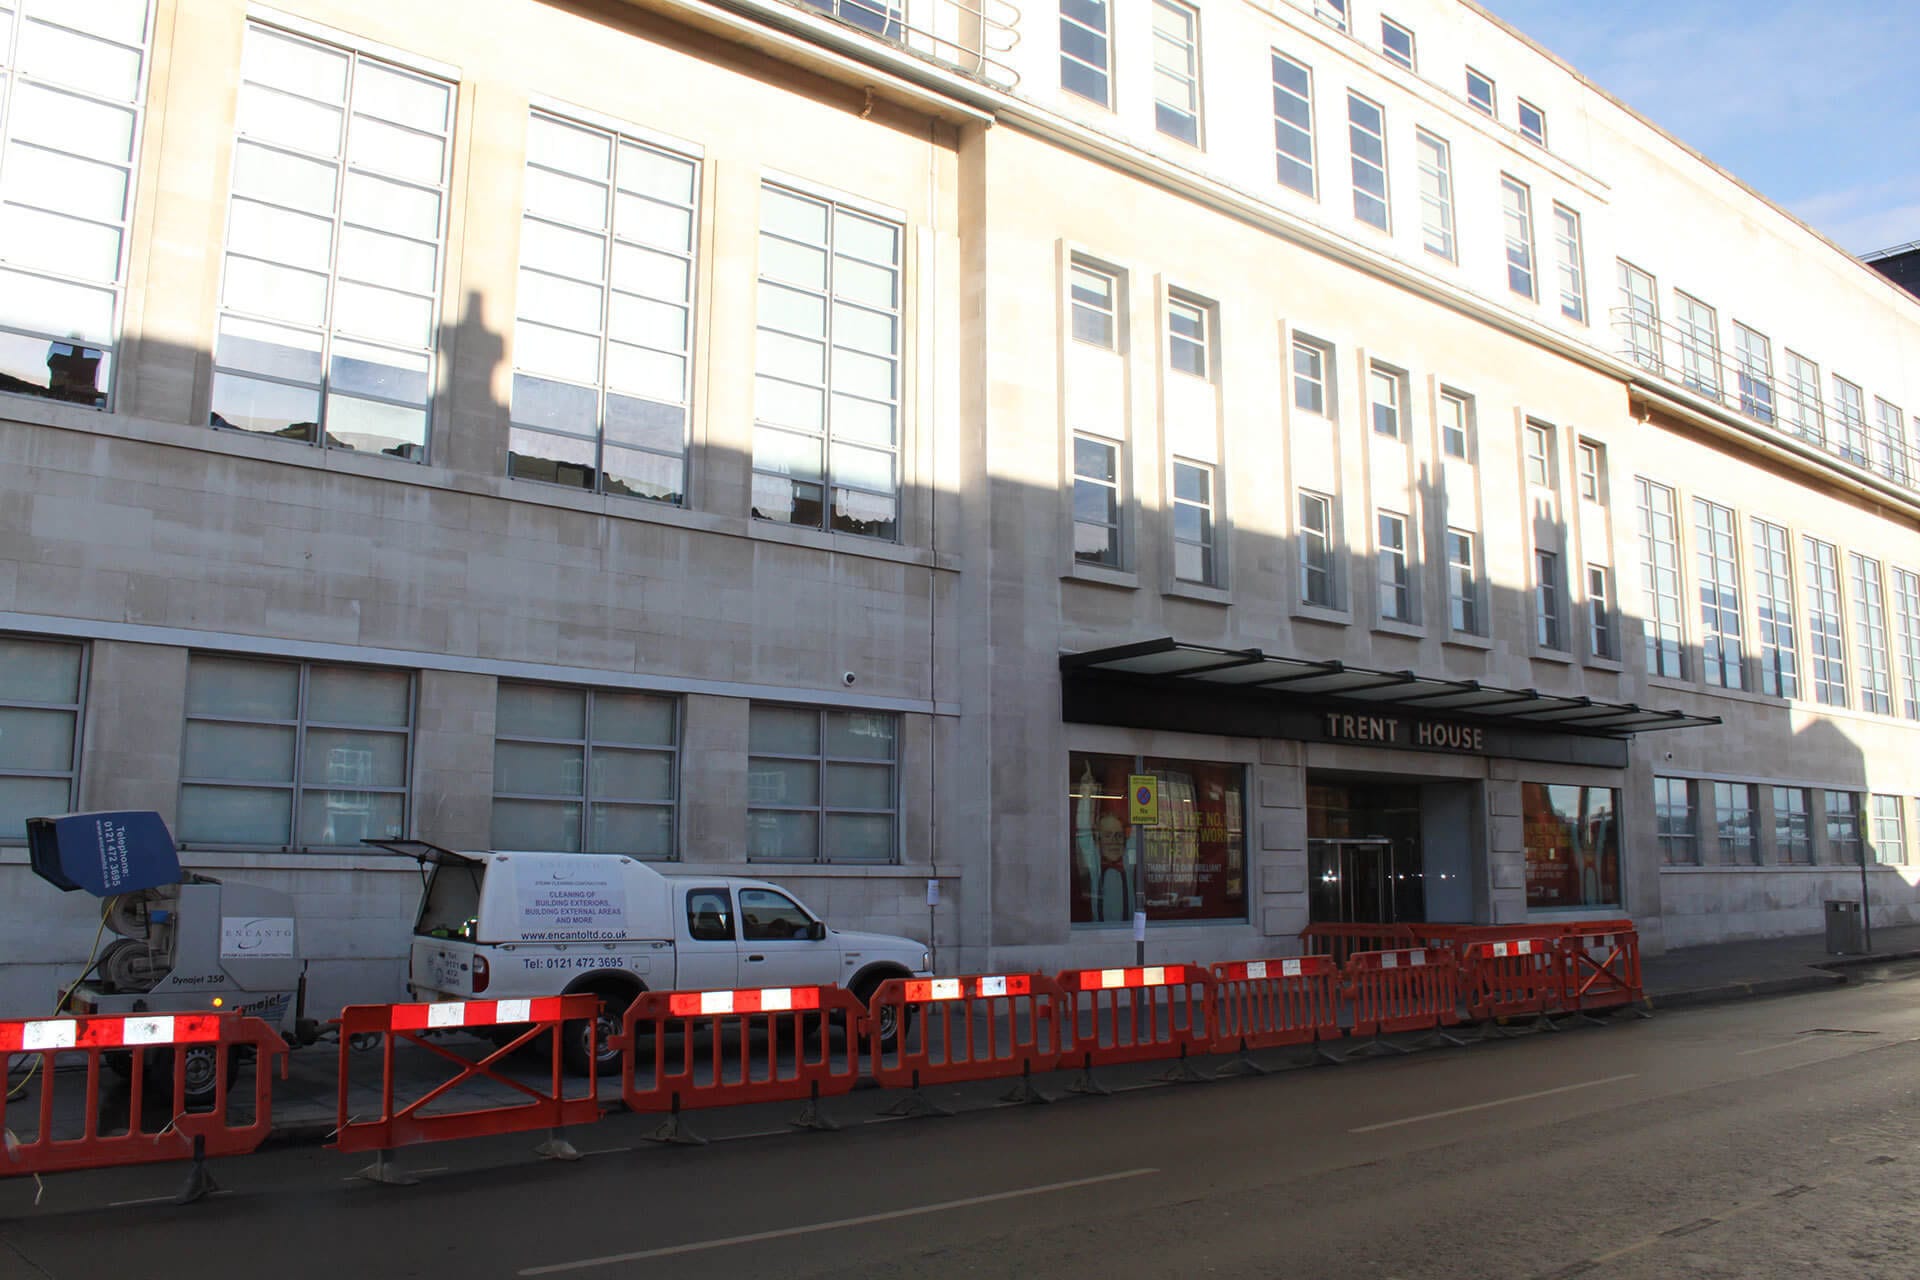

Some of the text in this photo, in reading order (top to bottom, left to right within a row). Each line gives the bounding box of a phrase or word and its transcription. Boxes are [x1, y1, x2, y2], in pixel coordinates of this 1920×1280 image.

[1327, 713, 1483, 750] TRENT HOUSE
[104, 821, 121, 887] 0121 472 3695
[116, 825, 130, 877] Telephone:
[549, 891, 584, 899] CLEANING
[535, 899, 568, 907] BUILDING
[525, 908, 559, 916] BUILDING
[555, 916, 592, 924] AND MORE
[225, 929, 292, 937] ENCANTO
[520, 930, 627, 940] www.encantoltd.co.uk
[524, 956, 623, 969] Tel: 0121 472 3695
[172, 975, 225, 986] Dynajet 350
